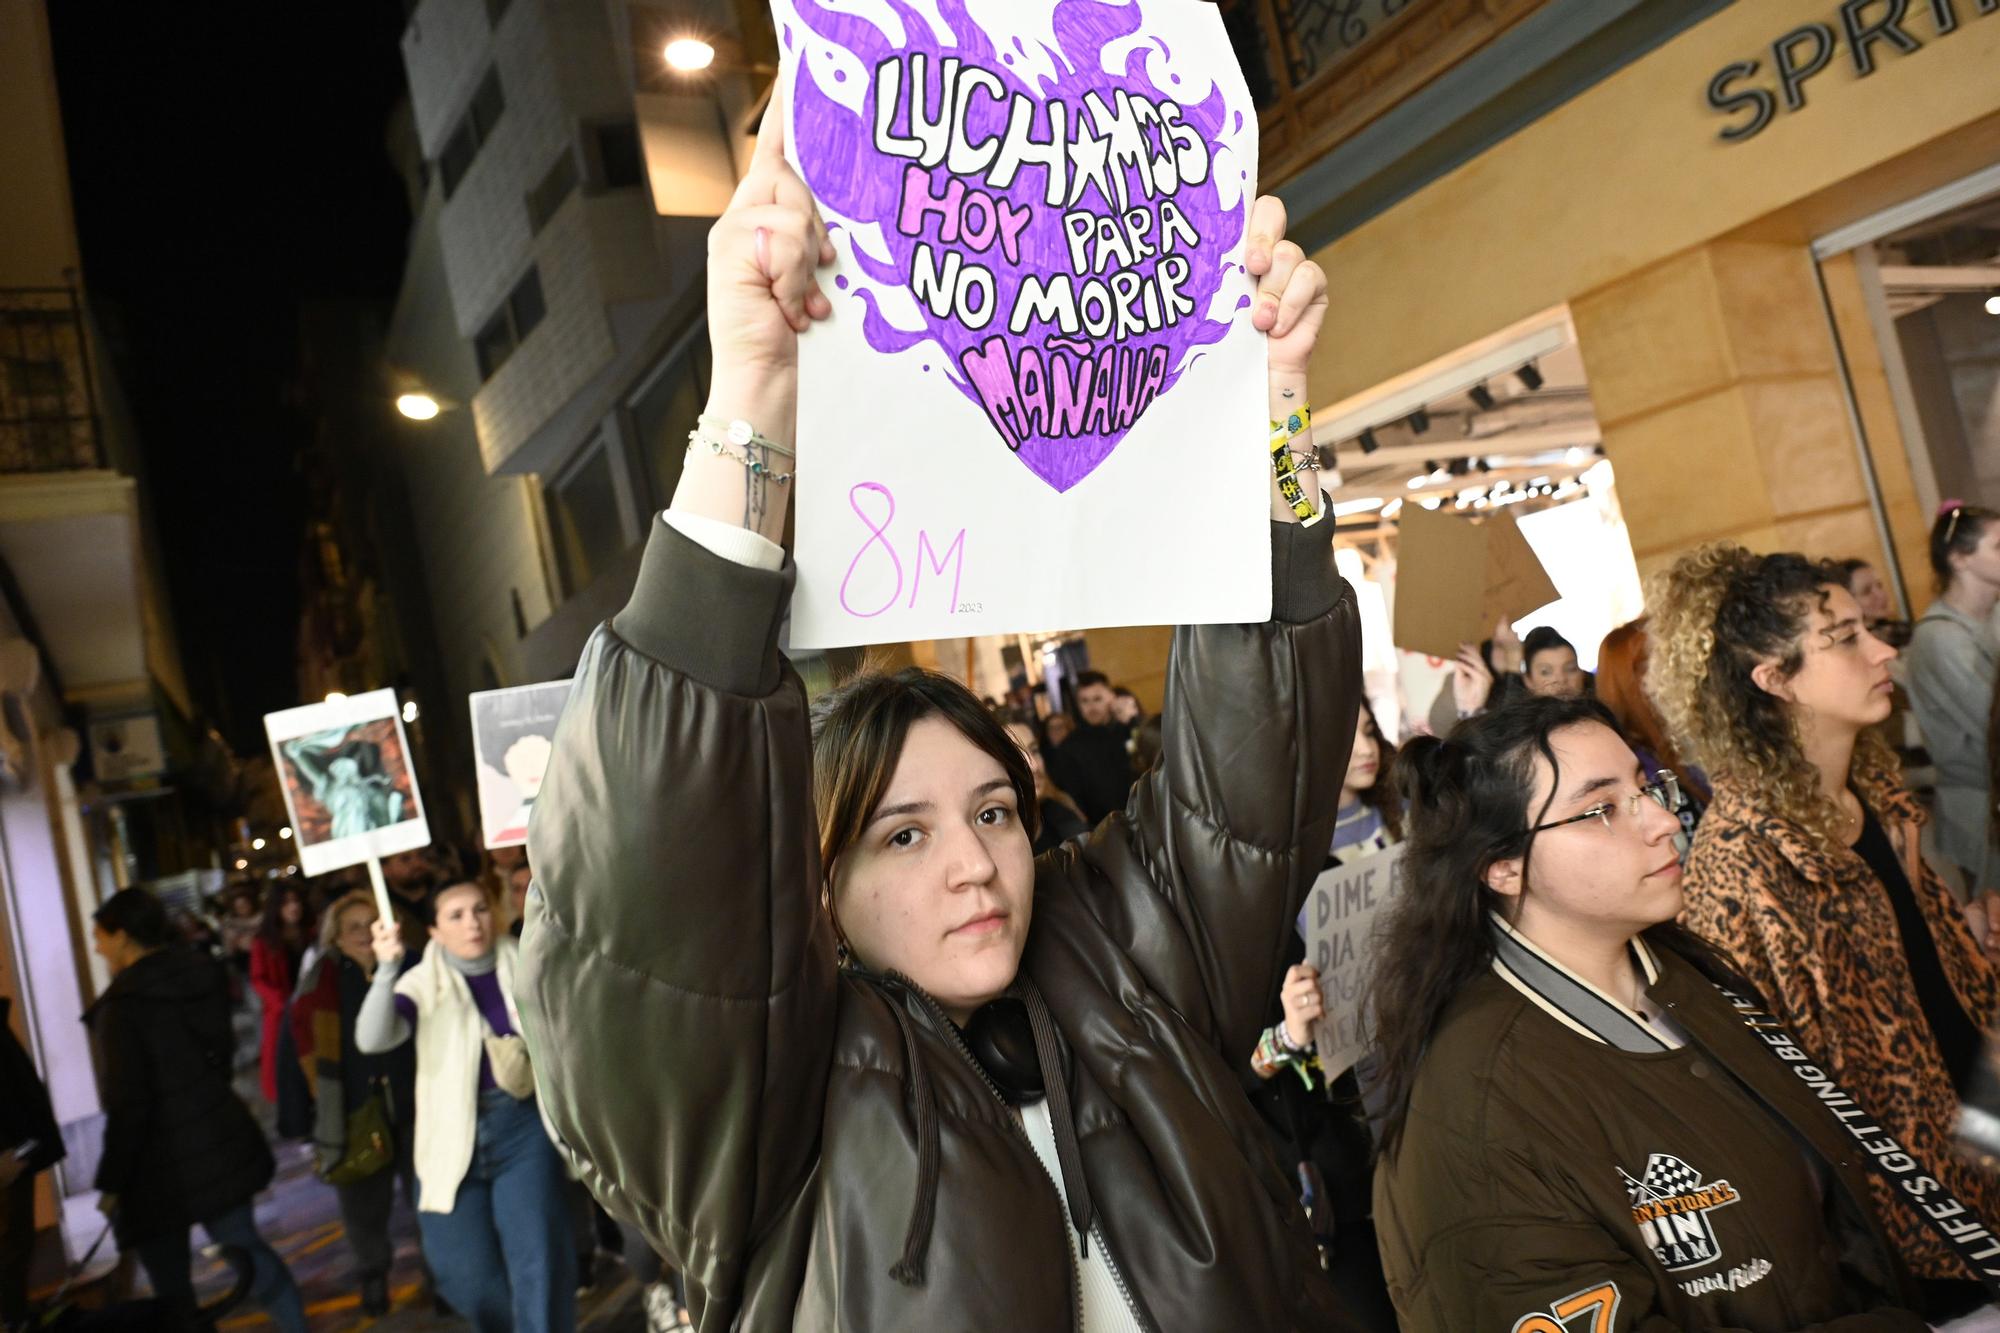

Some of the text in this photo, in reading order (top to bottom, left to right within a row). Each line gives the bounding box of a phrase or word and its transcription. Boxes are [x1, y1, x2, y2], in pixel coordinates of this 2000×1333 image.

[1706, 0, 2000, 143] SPR
[897, 164, 1200, 276] HOY PARA
[909, 242, 1195, 340] NO MORIR
[960, 334, 1170, 451] MAÑANA
[1317, 868, 1376, 930] DIME
[1793, 1065, 1917, 1173] GETTING
[1902, 1176, 2000, 1261] LIFE'S
